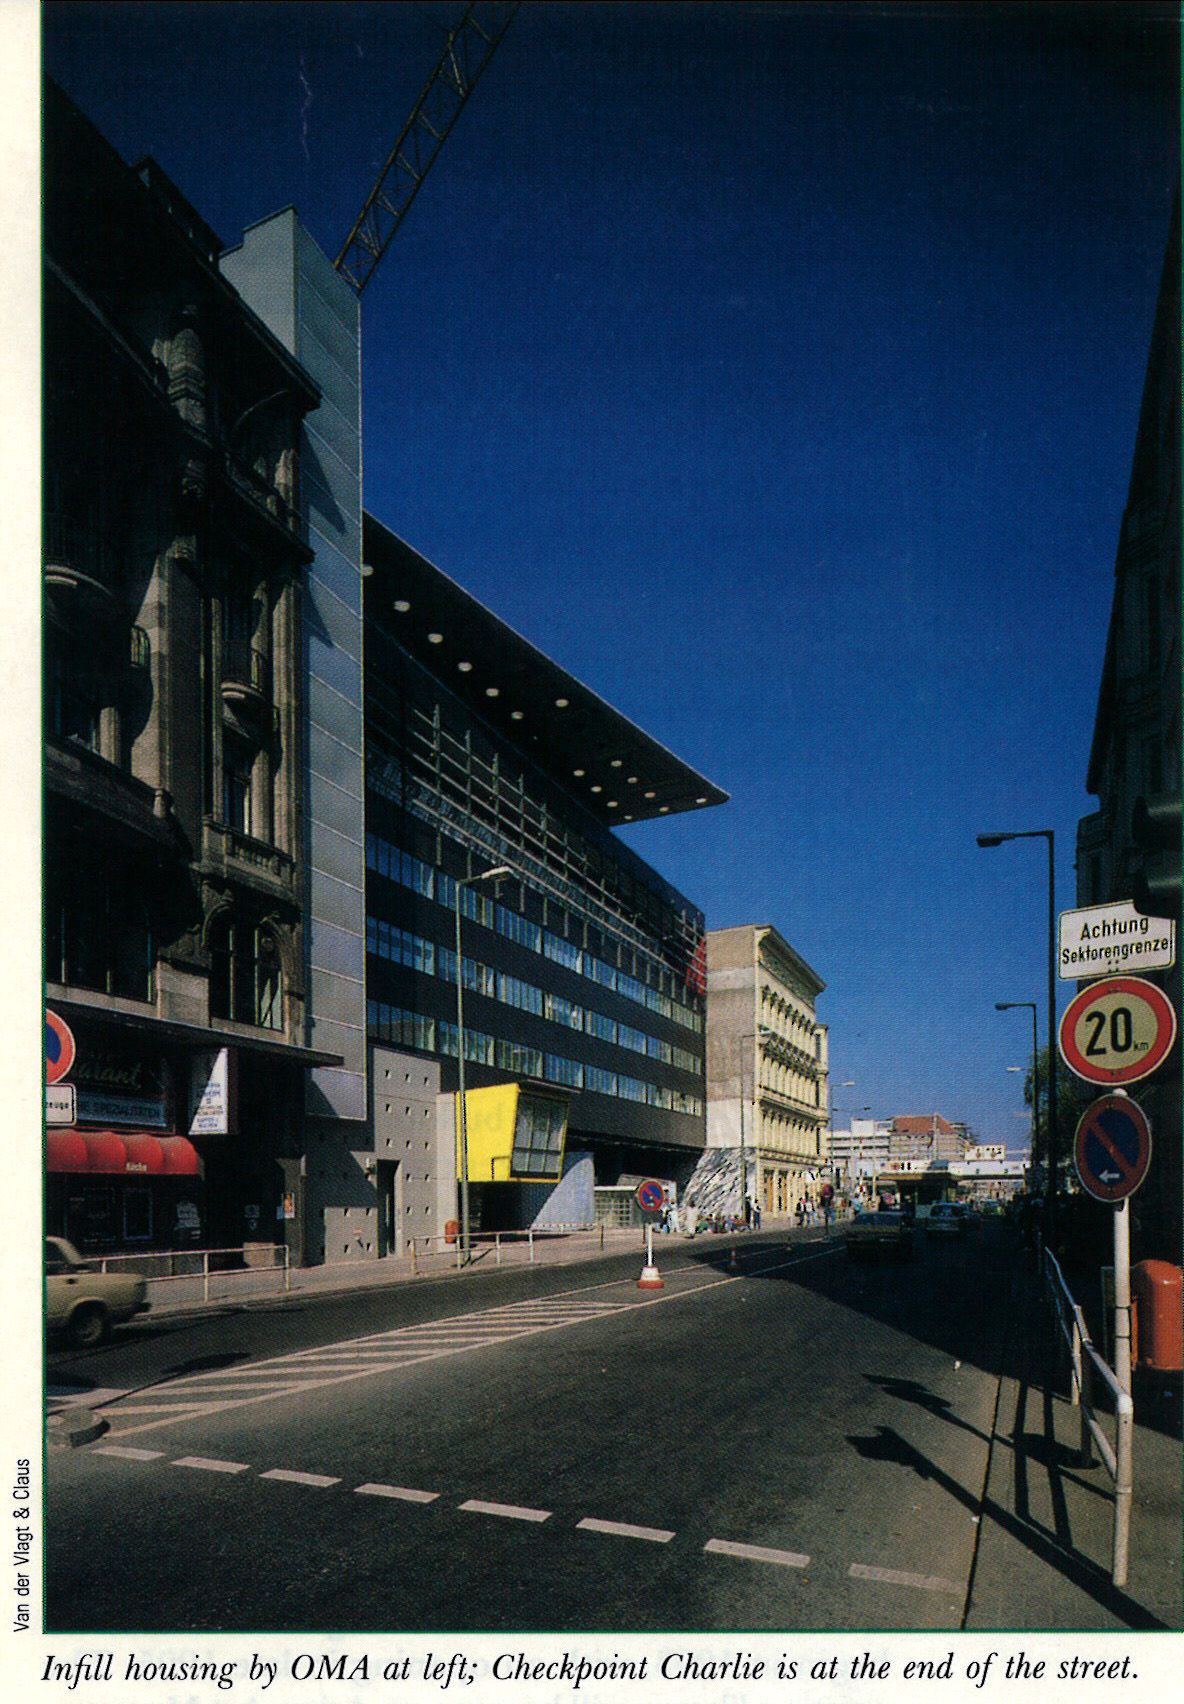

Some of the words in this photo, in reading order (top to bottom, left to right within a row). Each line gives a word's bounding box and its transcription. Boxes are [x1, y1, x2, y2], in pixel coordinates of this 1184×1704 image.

[1080, 917, 1149, 941] Achtung
[1085, 1006, 1133, 1057] 20
[1133, 1040, 1149, 1052] km
